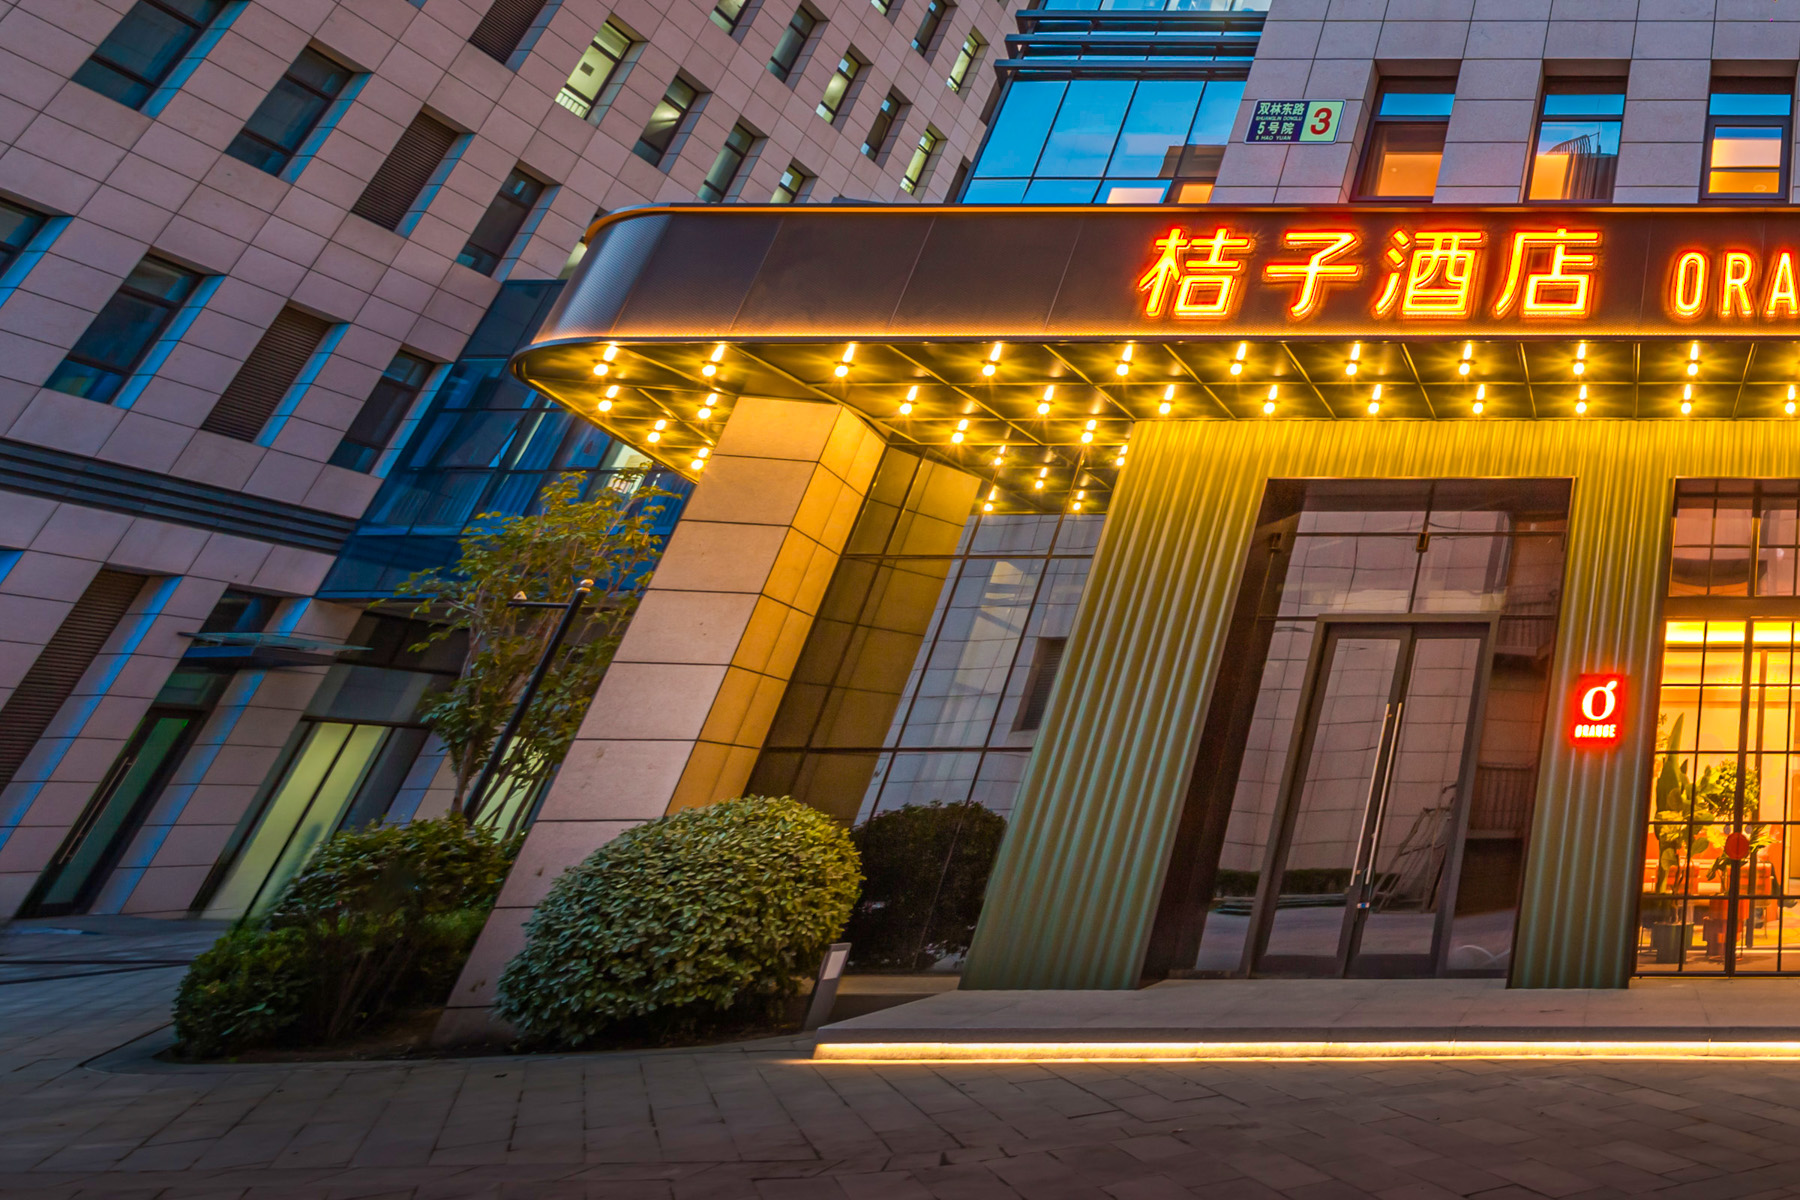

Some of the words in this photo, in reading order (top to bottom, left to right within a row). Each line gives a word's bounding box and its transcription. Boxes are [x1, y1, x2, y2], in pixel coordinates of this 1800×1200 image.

[1257, 102, 1305, 115] 双林东路
[1257, 121, 1295, 135] 5号院
[1310, 107, 1333, 136] 3
[1138, 227, 1602, 320] 桔子酒店
[1574, 724, 1617, 738] ORANGE
